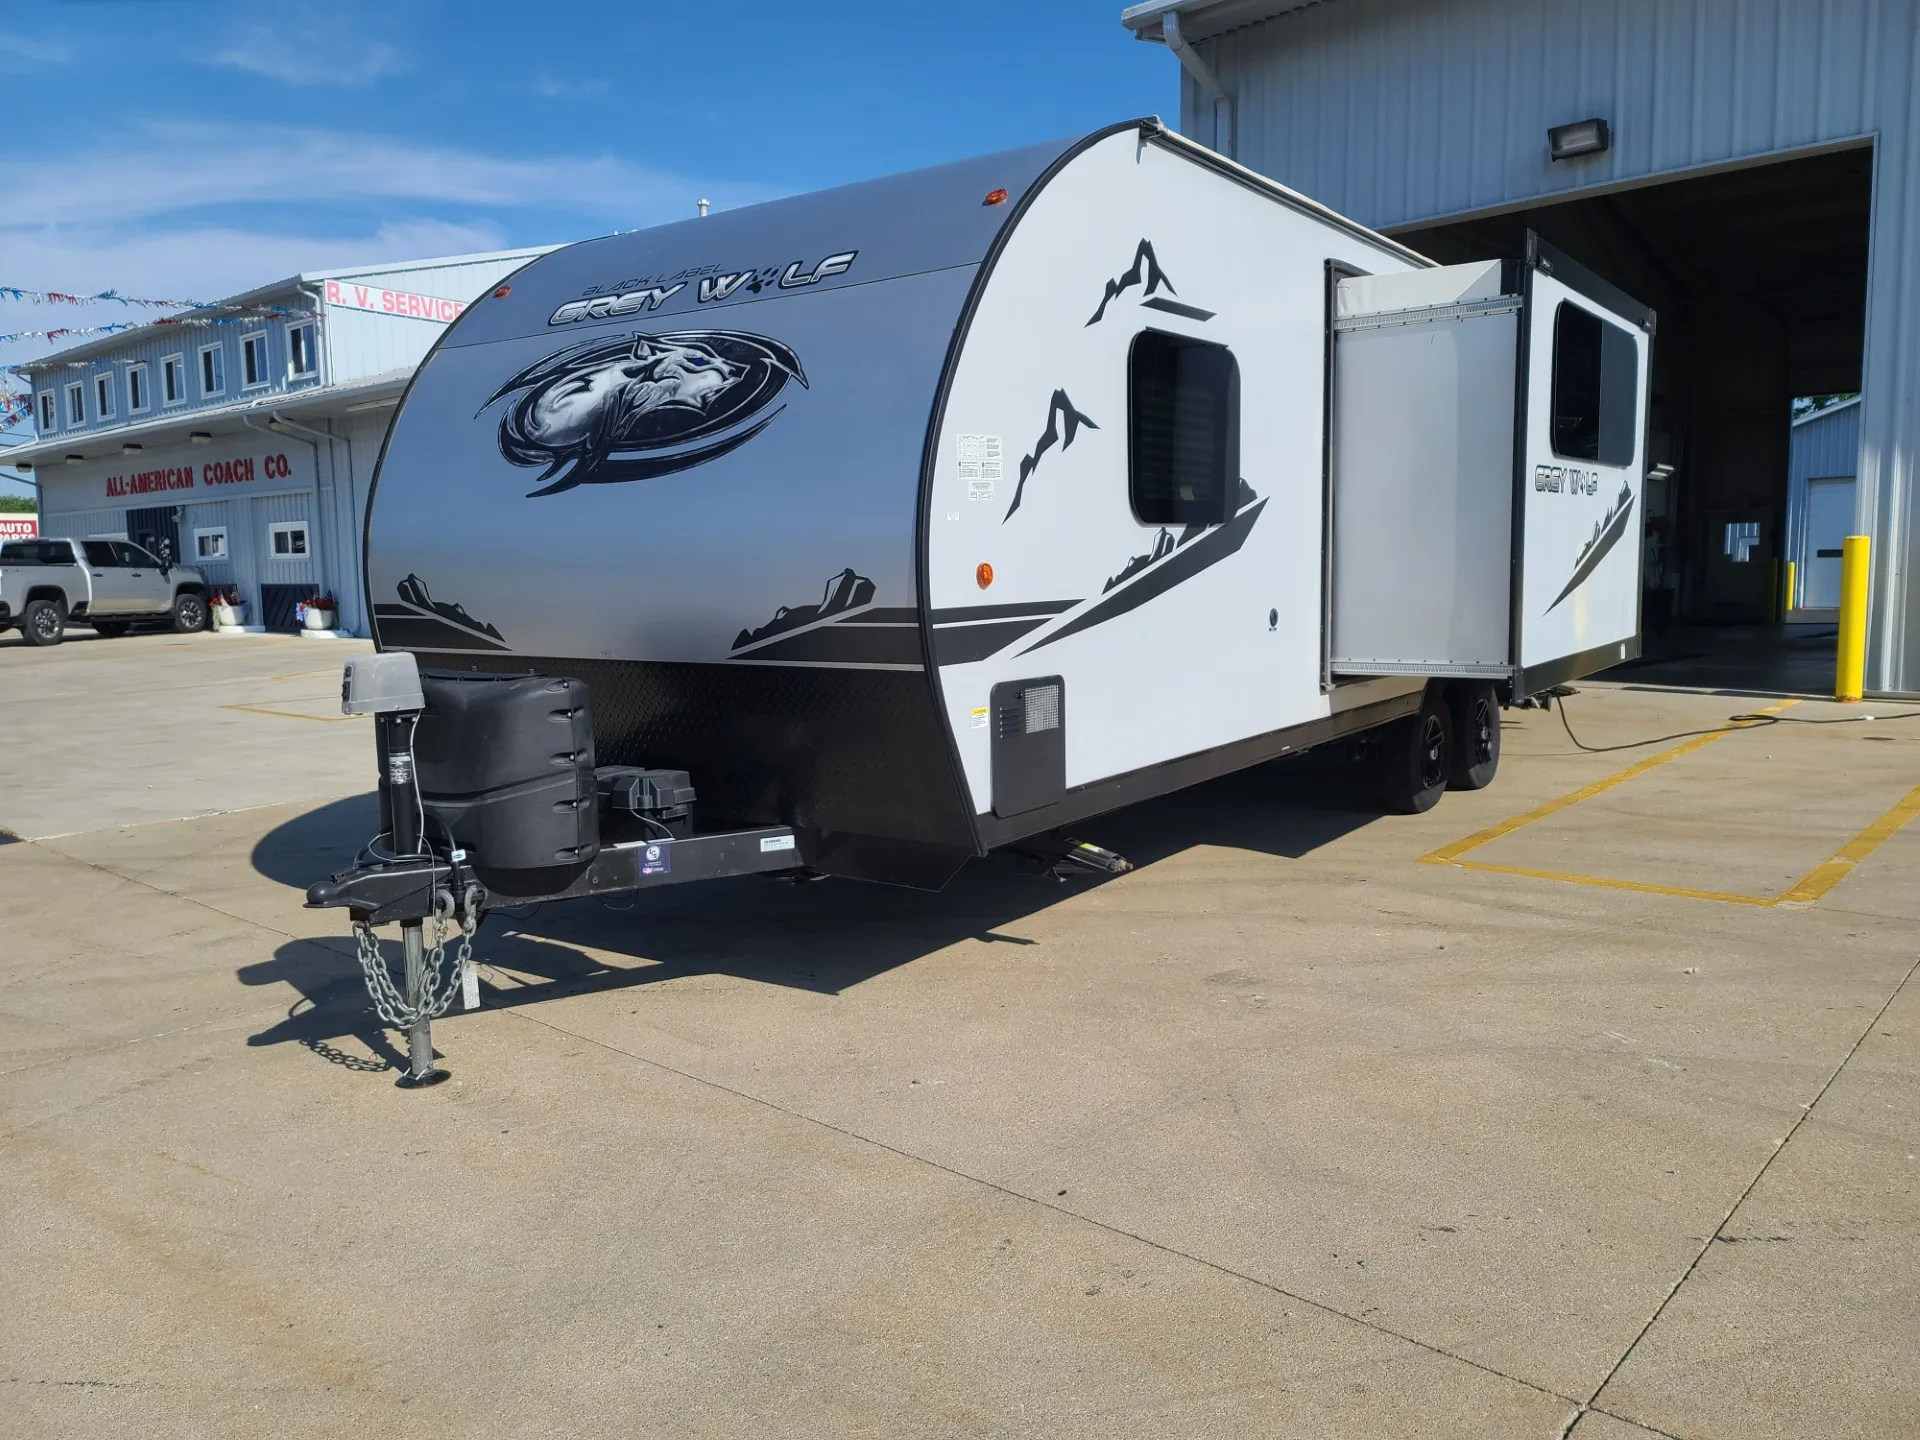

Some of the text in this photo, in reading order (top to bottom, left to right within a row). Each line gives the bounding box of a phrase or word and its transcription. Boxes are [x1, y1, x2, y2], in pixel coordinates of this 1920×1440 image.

[582, 263, 725, 296] BLACK LABEL
[326, 281, 464, 321] R. V. SERVICE
[548, 281, 689, 326] GREY
[106, 454, 292, 497] ALL-AMERICAN COACH CO.
[1535, 465, 1567, 493] GREY
[0, 522, 32, 534] AUTO
